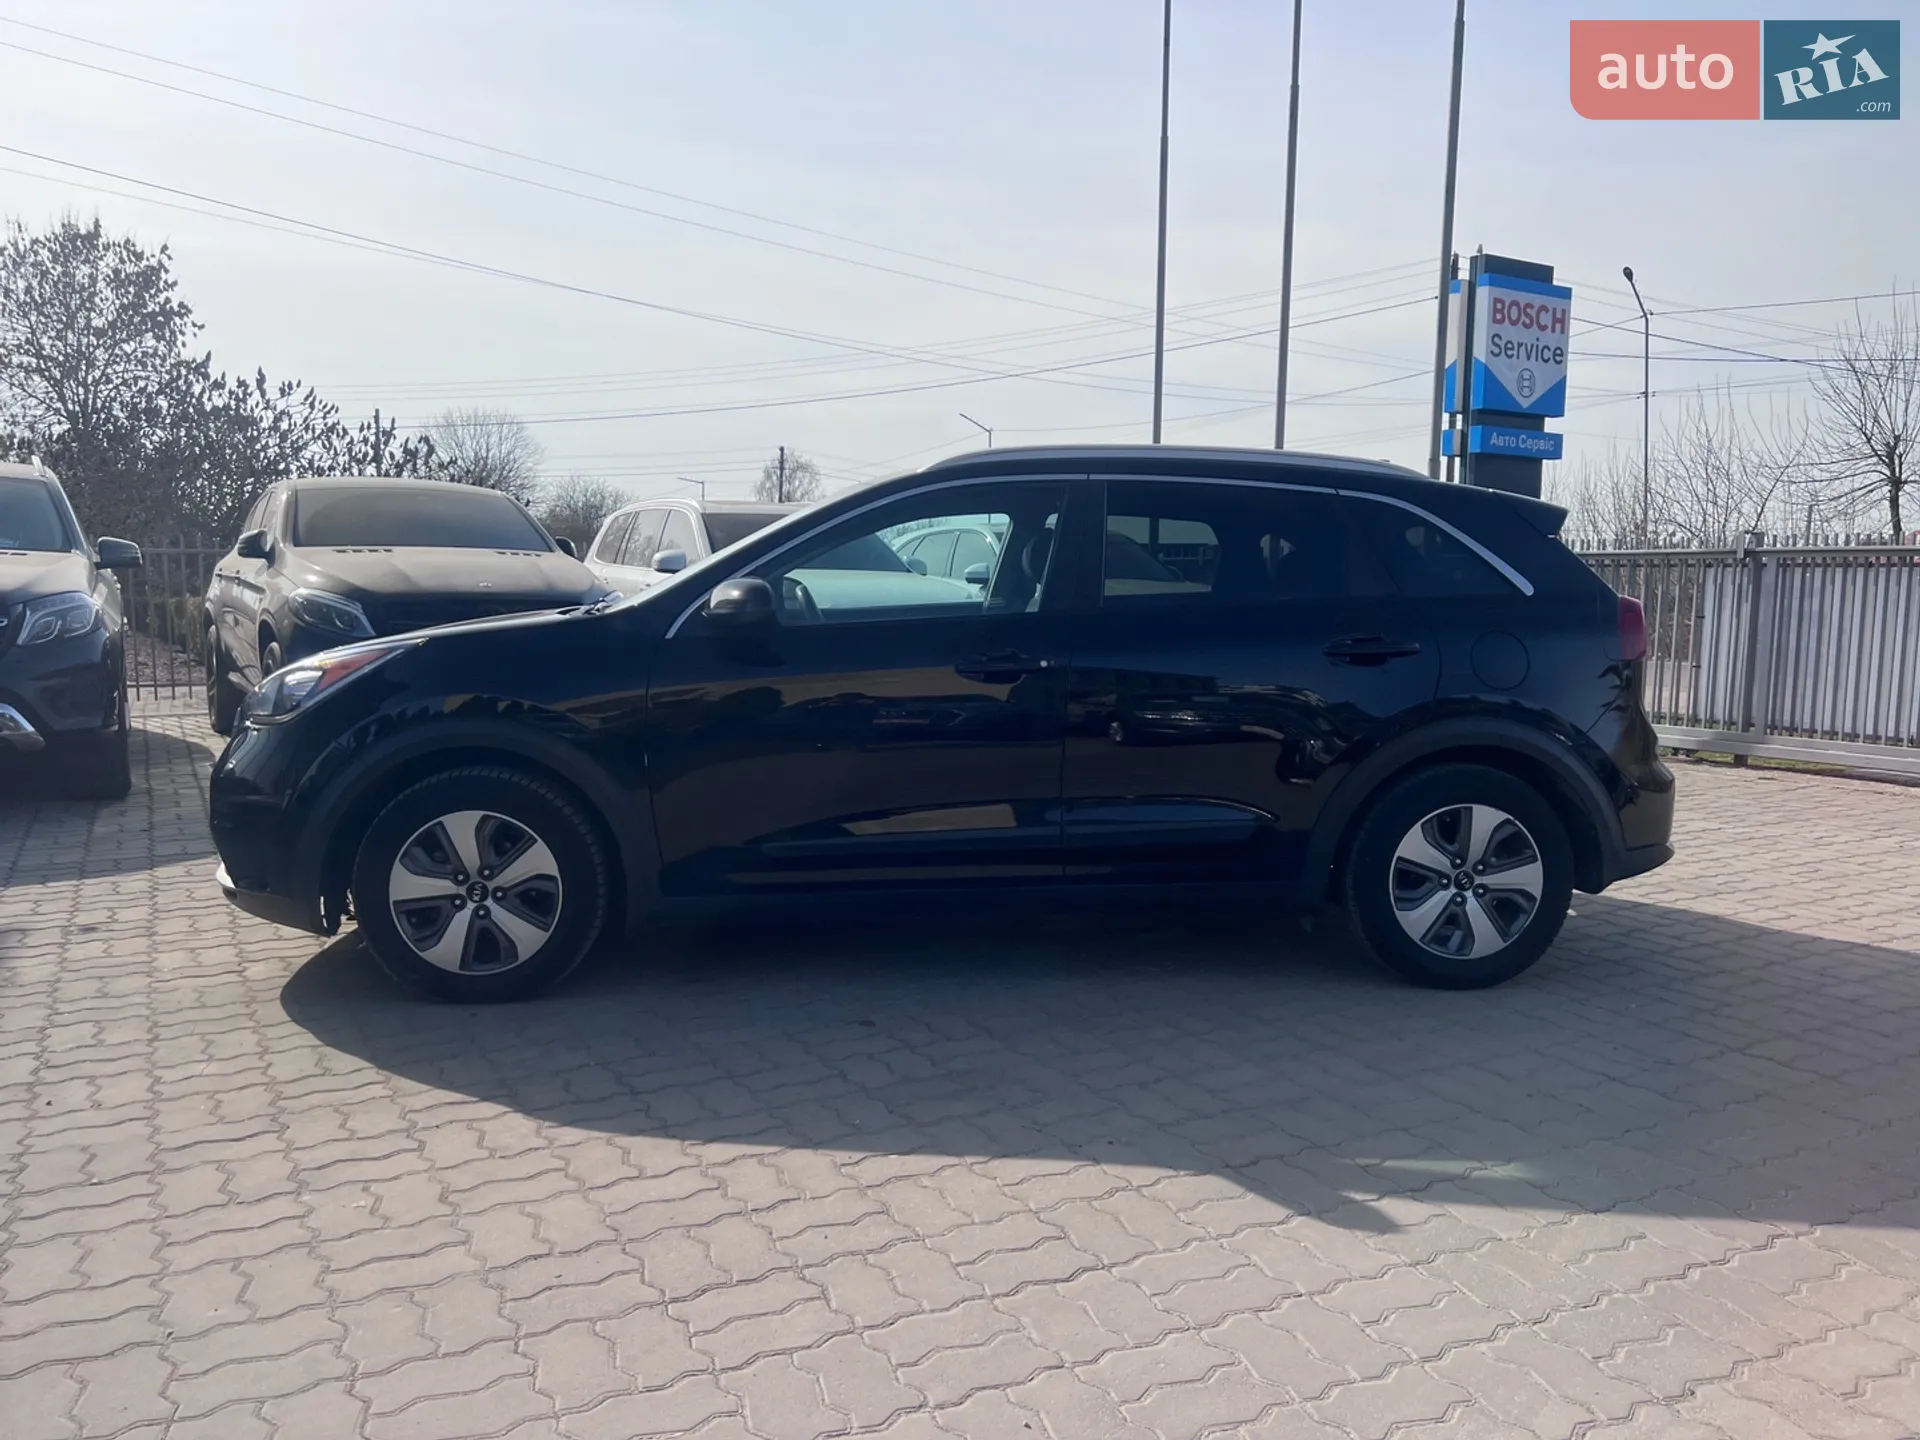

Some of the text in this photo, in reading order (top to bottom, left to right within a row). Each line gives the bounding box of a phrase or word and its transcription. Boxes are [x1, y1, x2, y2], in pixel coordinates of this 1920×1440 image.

[1491, 297, 1566, 334] BOSCH
[1489, 333, 1564, 365] Service
[1490, 431, 1555, 452] Авто Сервіс
